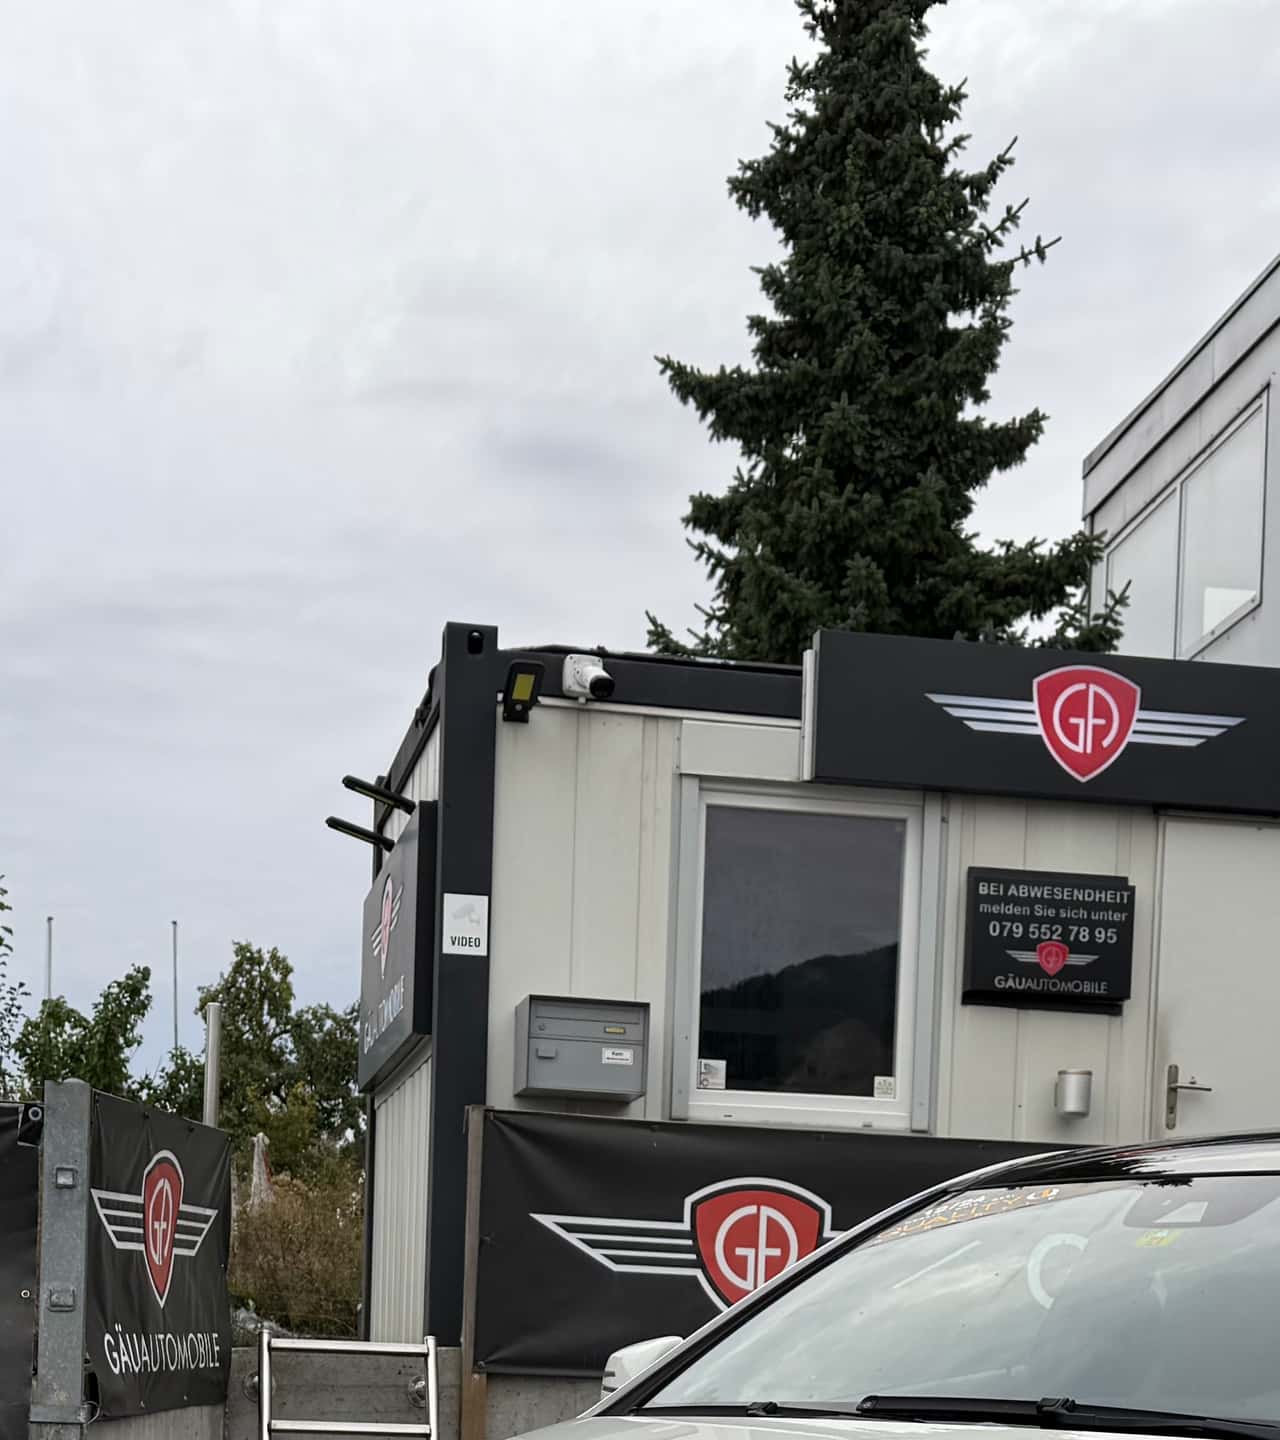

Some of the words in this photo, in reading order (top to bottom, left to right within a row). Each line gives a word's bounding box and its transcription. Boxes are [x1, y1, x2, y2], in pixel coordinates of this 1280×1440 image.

[978, 882, 1004, 896] BEI
[1008, 884, 1130, 904] ABWESENDHEIT
[979, 903, 1030, 916] melden
[1033, 904, 1057, 918] Sie
[1058, 906, 1088, 920] sich
[1090, 910, 1129, 922] unter
[450, 935, 481, 948] VIDEO
[988, 920, 1024, 939] 079
[1028, 923, 1063, 941] 552
[1068, 925, 1090, 943] 78
[1094, 927, 1119, 944] 95
[993, 973, 1109, 994] GÄUAUTOMOBILE
[104, 1323, 220, 1376] GÄUAUTOMOBILE
